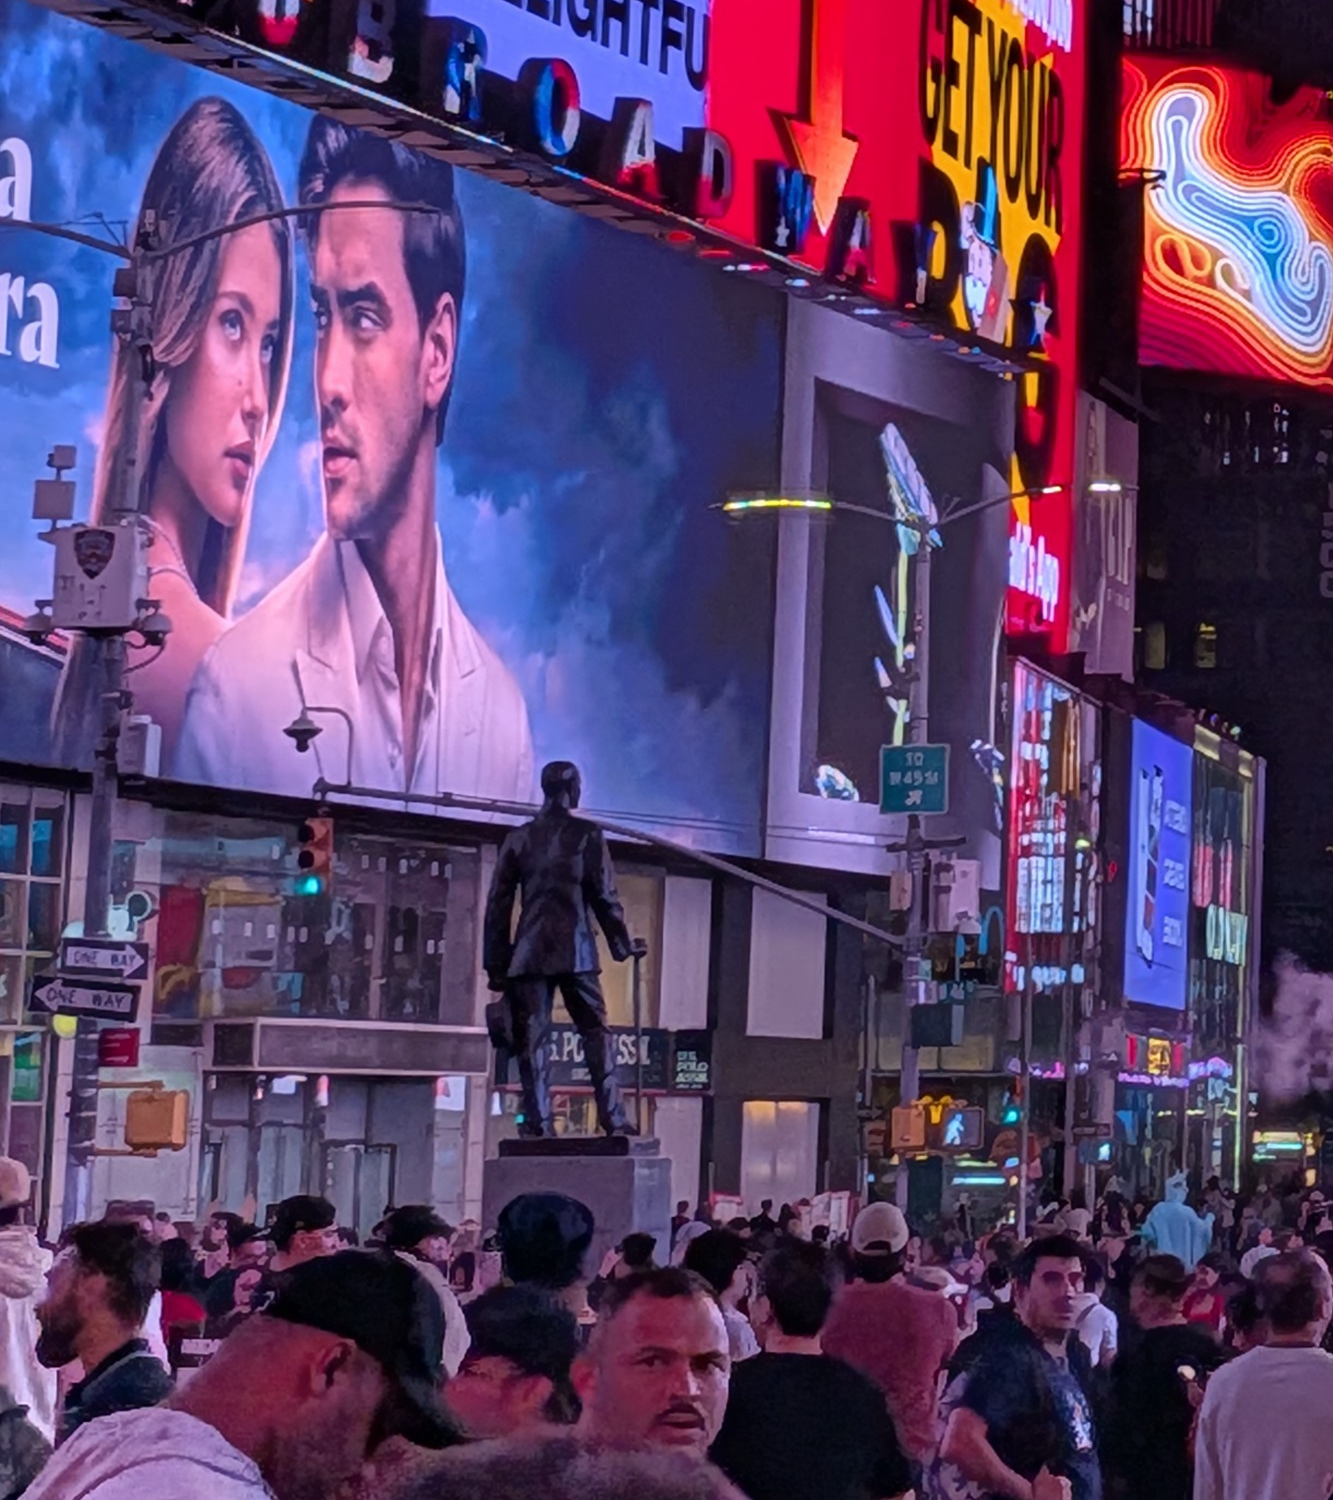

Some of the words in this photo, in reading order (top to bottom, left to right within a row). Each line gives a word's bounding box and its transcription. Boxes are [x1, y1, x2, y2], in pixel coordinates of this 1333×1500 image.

[987, 16, 1064, 236] YOUR
[74, 950, 98, 965] ONE
[46, 986, 76, 1004] ONE
[91, 994, 125, 1009] WAY
